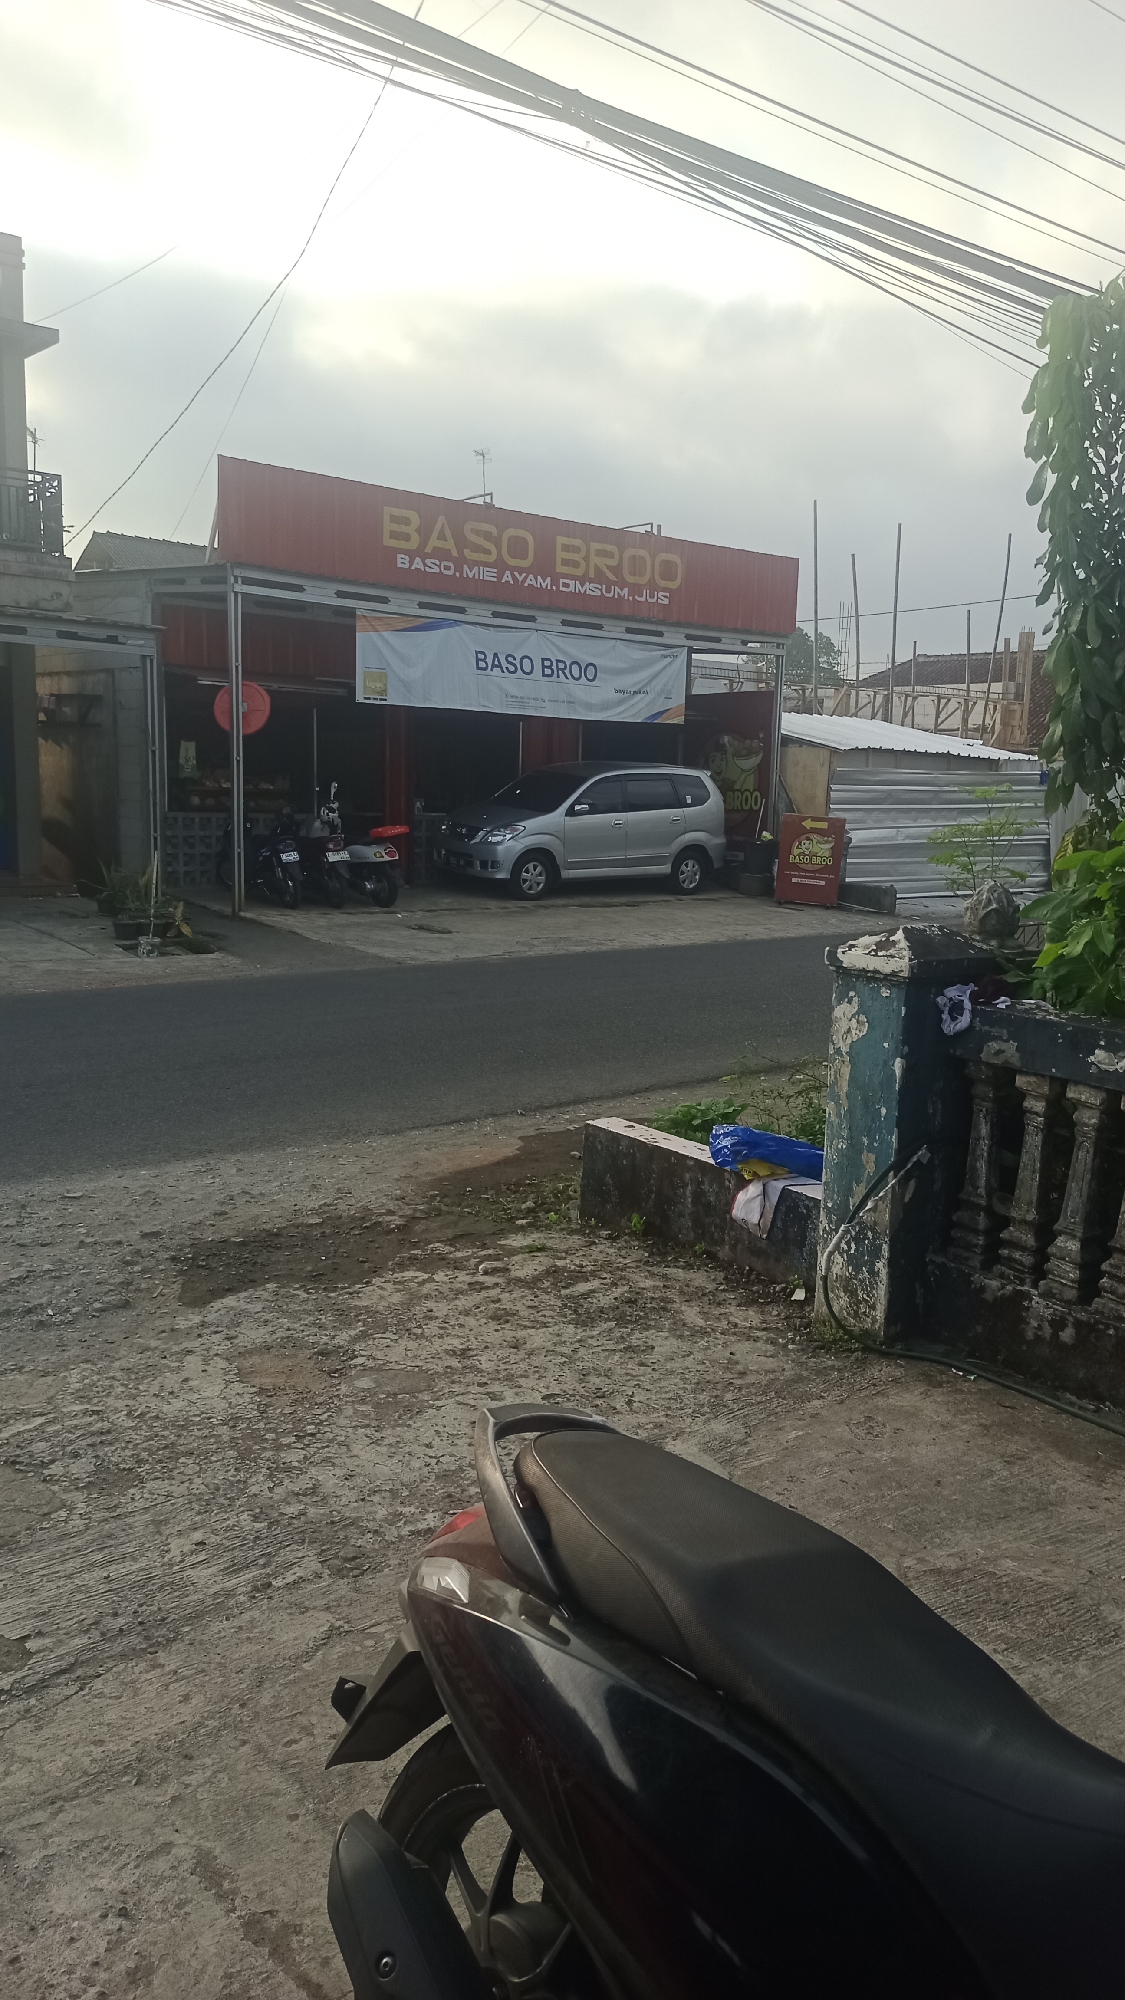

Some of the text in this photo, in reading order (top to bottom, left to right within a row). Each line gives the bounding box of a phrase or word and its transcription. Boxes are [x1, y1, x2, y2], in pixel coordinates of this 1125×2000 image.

[382, 505, 683, 590] BASO BROO
[396, 553, 670, 605] BASO, MIE AYAM, DIMSUM, JUS
[474, 649, 598, 683] BASO BROO
[725, 790, 761, 811] BROO
[789, 854, 833, 865] BASO BROO
